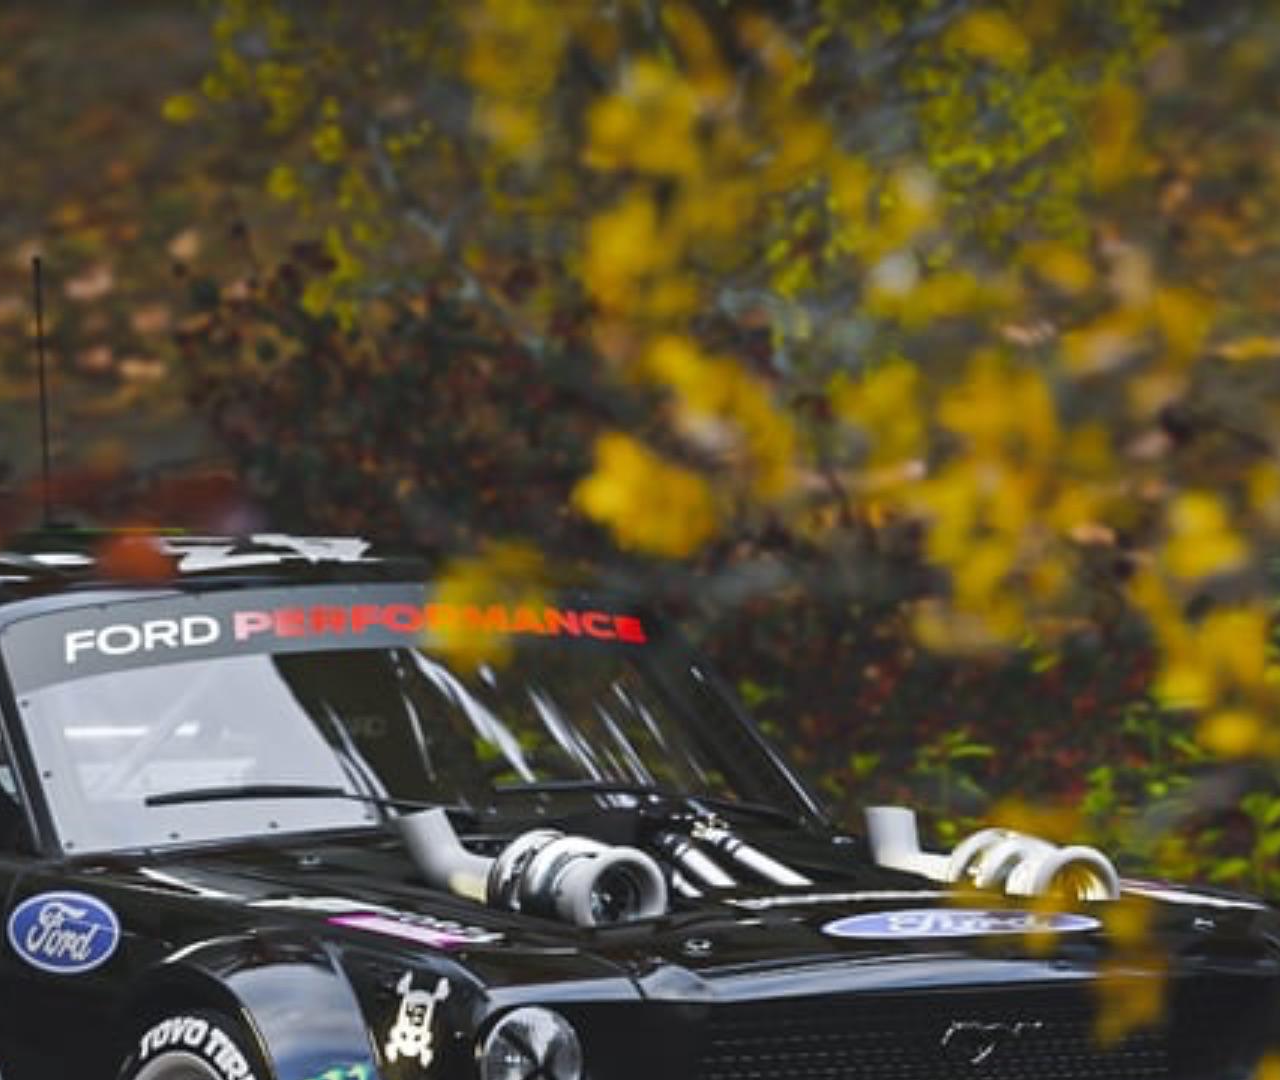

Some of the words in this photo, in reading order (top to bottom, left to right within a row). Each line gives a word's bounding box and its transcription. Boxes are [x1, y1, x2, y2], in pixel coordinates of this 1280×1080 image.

[65, 613, 220, 664] FORD
[233, 603, 648, 645] PERFORMANCE
[25, 901, 98, 962] Ford
[140, 1016, 210, 1060] TOYO
